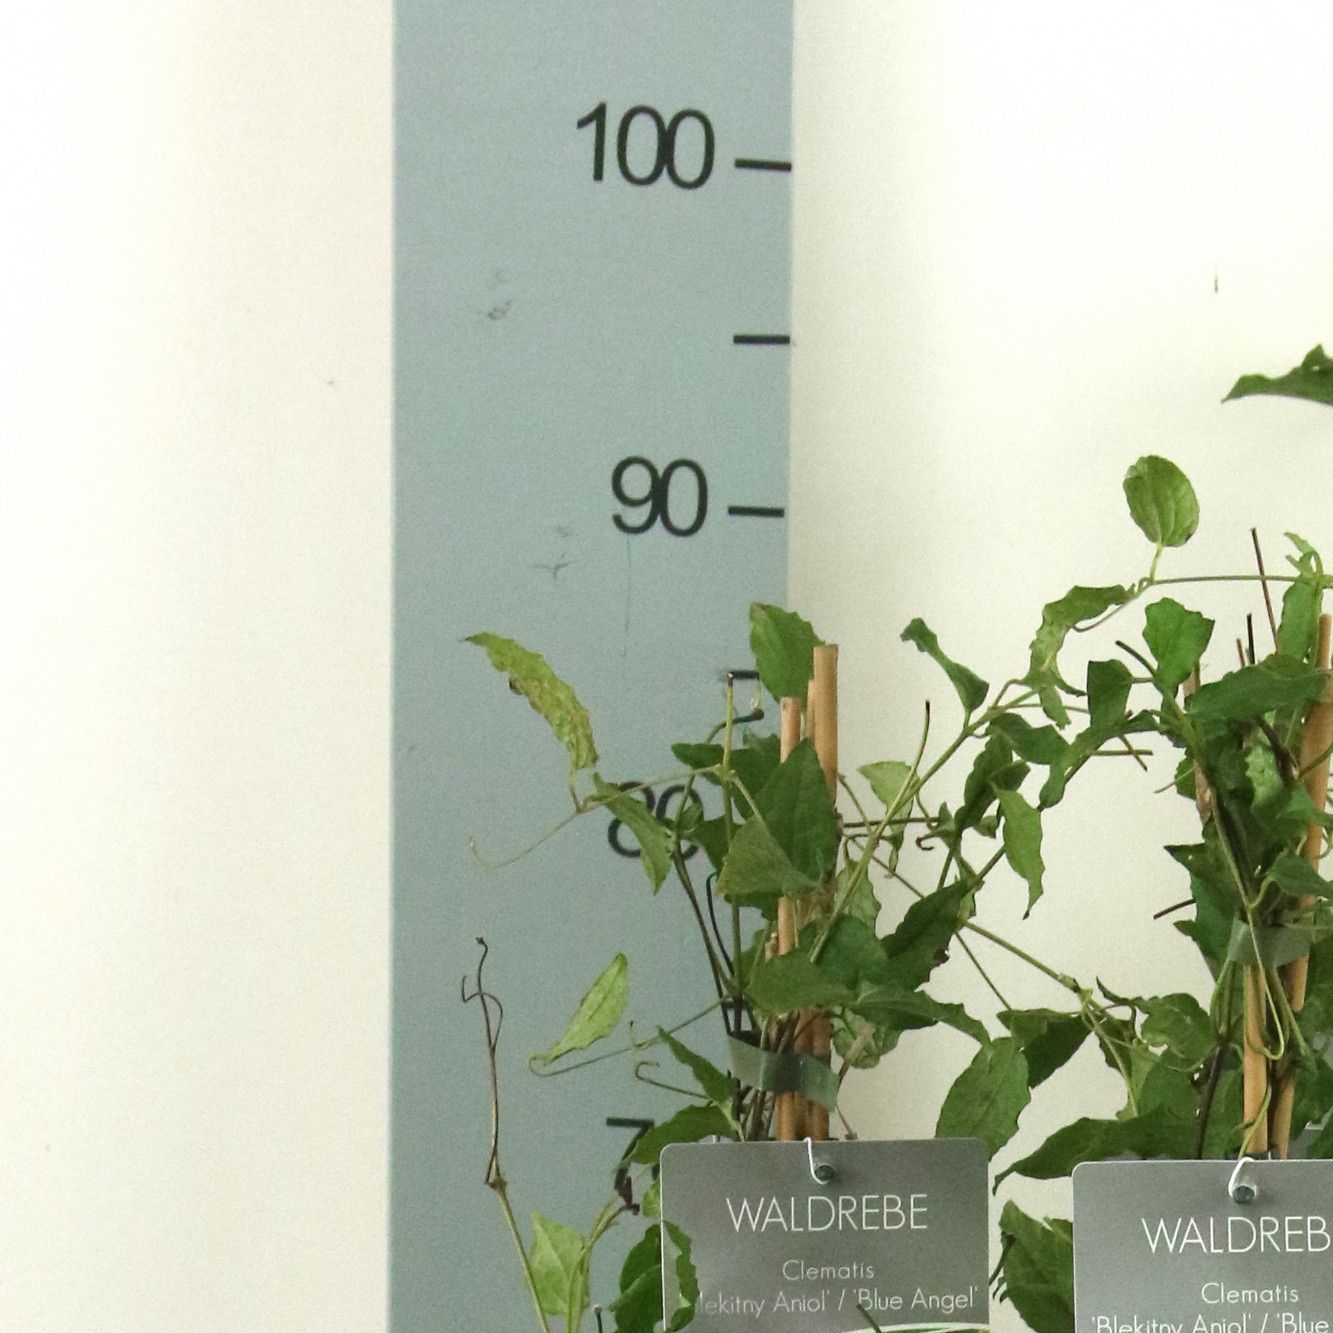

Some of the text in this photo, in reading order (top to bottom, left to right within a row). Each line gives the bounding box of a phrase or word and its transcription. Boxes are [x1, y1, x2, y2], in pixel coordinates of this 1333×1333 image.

[576, 101, 715, 189] 100
[610, 455, 709, 537] 90
[726, 1193, 928, 1233] WALDREBE
[782, 1259, 875, 1281] Clematis
[838, 1288, 846, 1311] /
[910, 1285, 979, 1314] Angel'
[1201, 1281, 1299, 1304] Clematis
